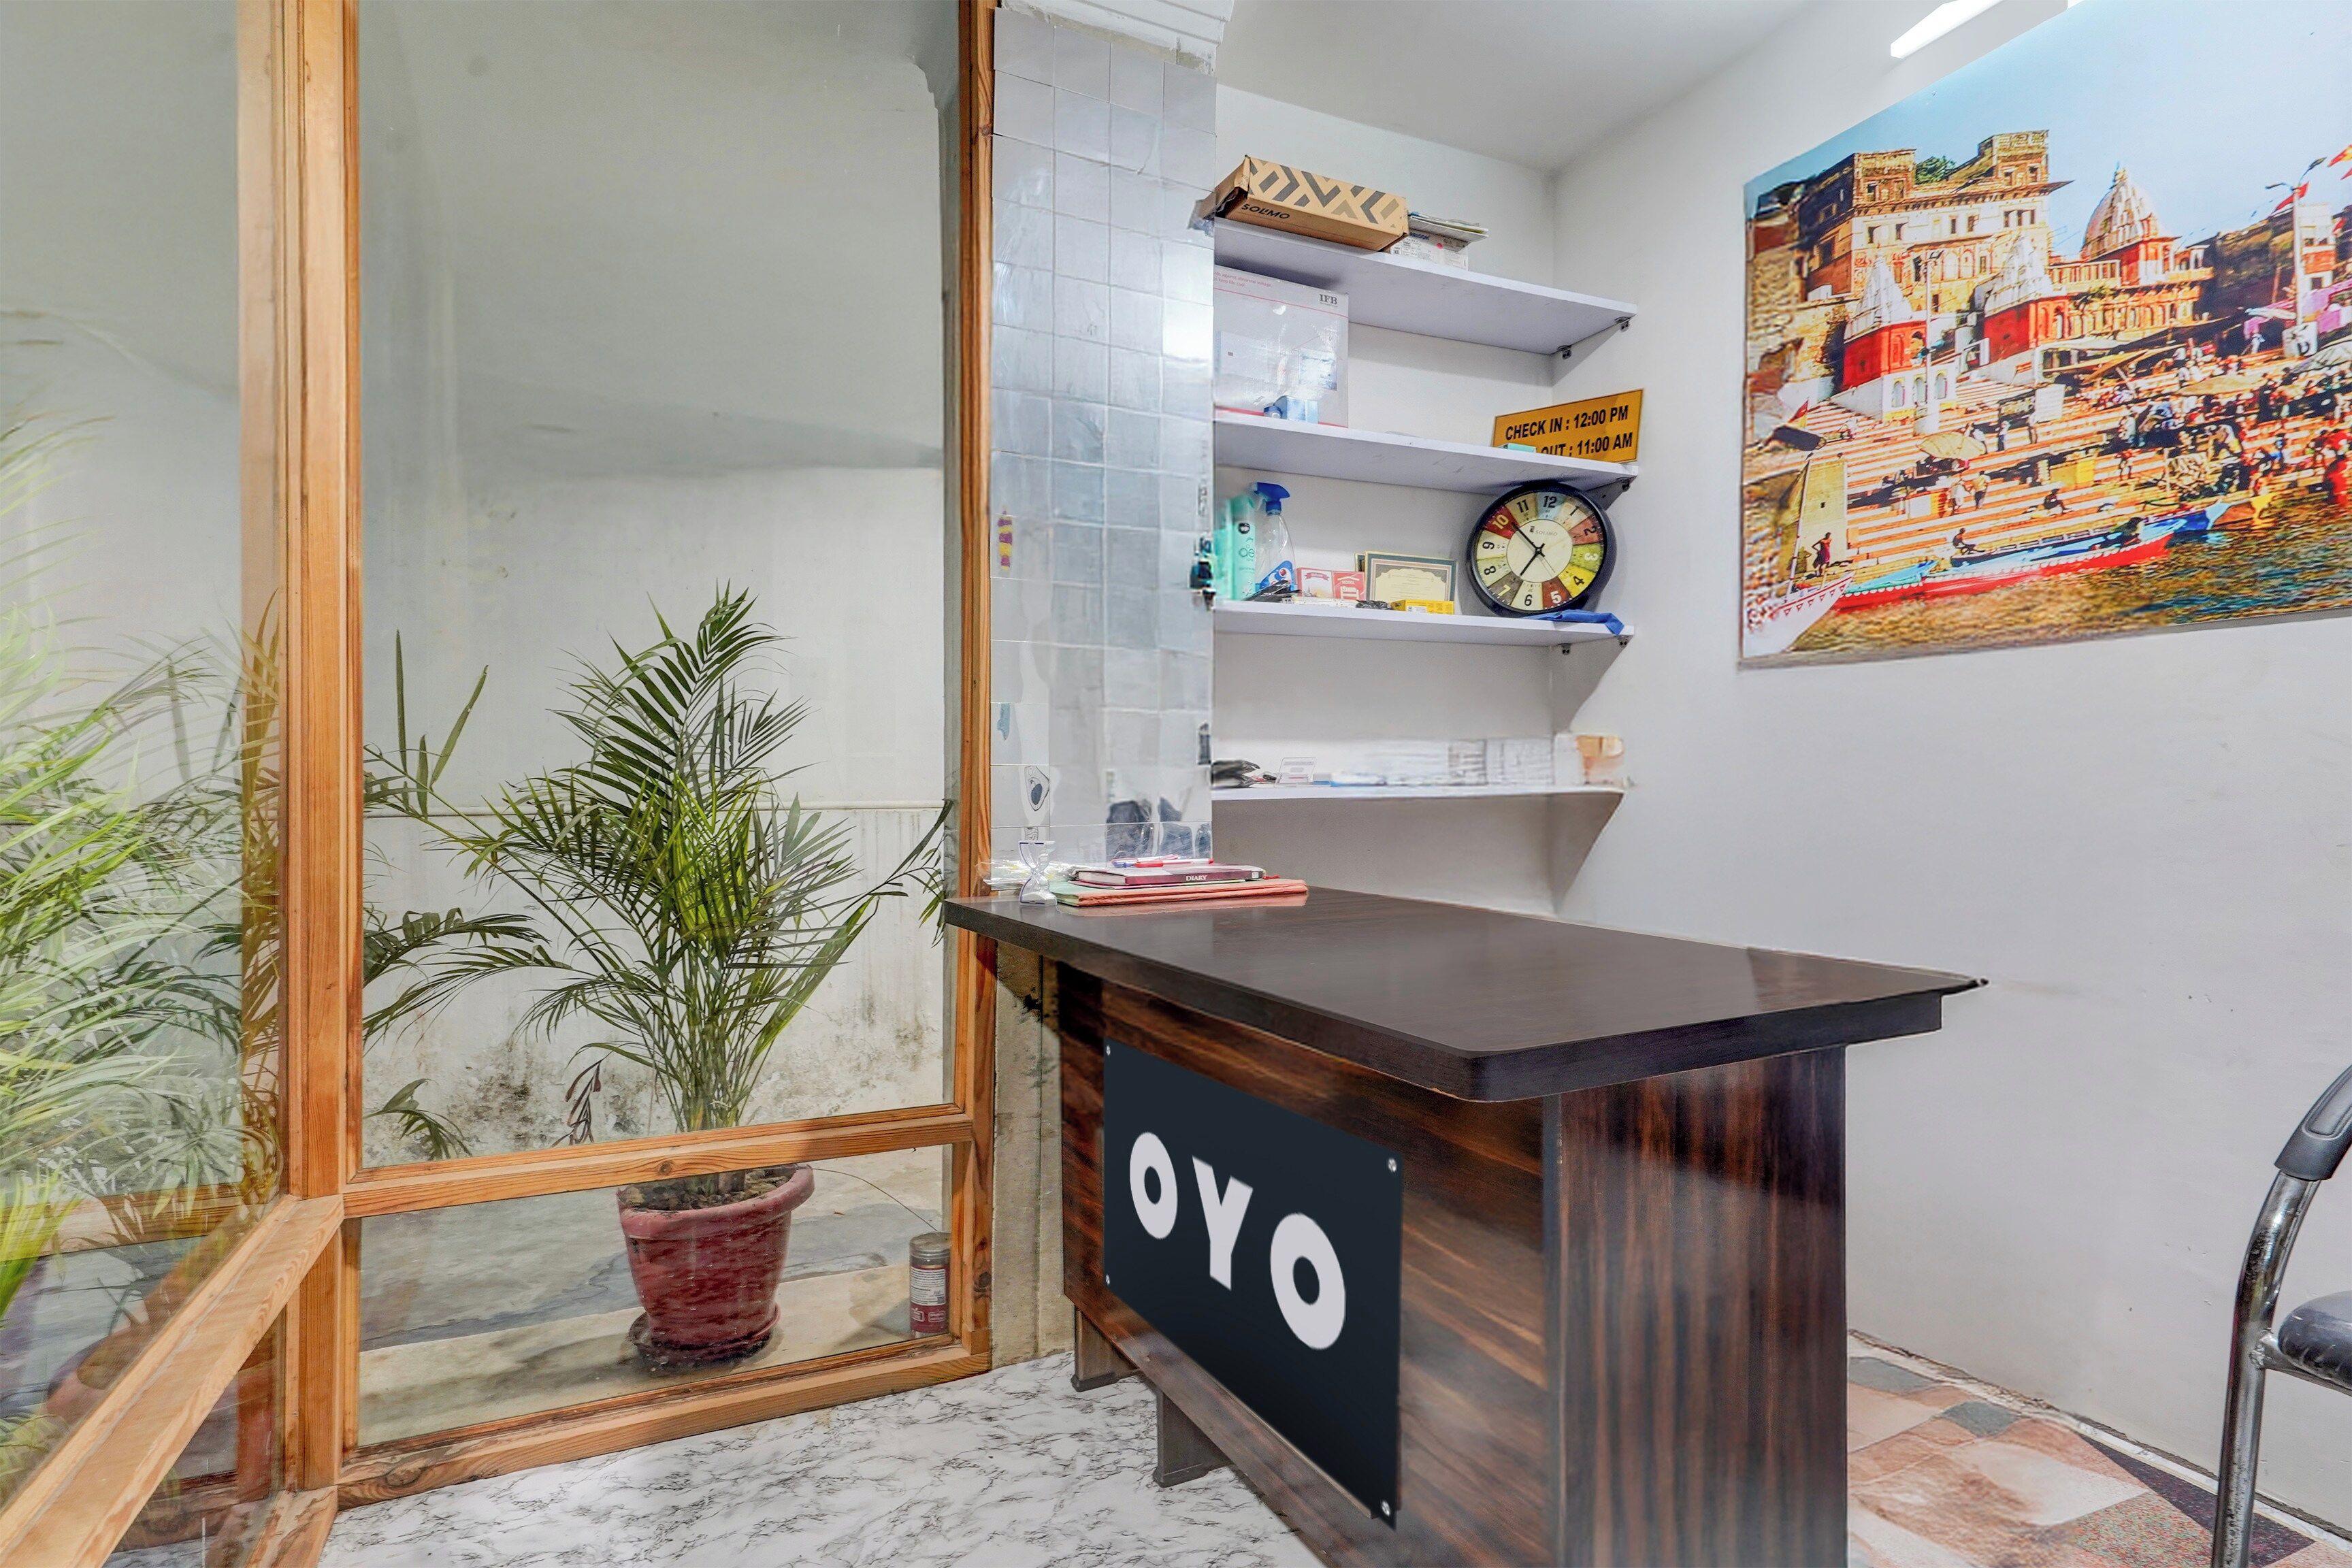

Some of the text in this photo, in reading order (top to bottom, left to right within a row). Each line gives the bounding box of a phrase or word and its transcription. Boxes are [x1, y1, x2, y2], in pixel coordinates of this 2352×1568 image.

[1241, 203, 1290, 219] SOLIMO
[1319, 294, 1338, 305] IFB
[1505, 419, 1546, 441] CHECK
[1549, 416, 1563, 433] IN
[1573, 408, 1606, 429] 12:00
[1610, 405, 1629, 423] PM
[1577, 436, 1610, 455] 11:00
[1612, 432, 1633, 449] AM
[1516, 499, 1530, 513] 11
[1543, 495, 1557, 508] 12
[1569, 506, 1580, 516] 1
[1492, 514, 1509, 529] 10
[1584, 525, 1597, 536] 2
[1584, 552, 1599, 561] 3
[1484, 566, 1497, 575] 8
[1573, 575, 1585, 586] 4
[1498, 585, 1511, 597] 7
[1550, 590, 1562, 604] 5
[1524, 594, 1533, 606] 6
[1128, 1131, 1347, 1350] OYO
